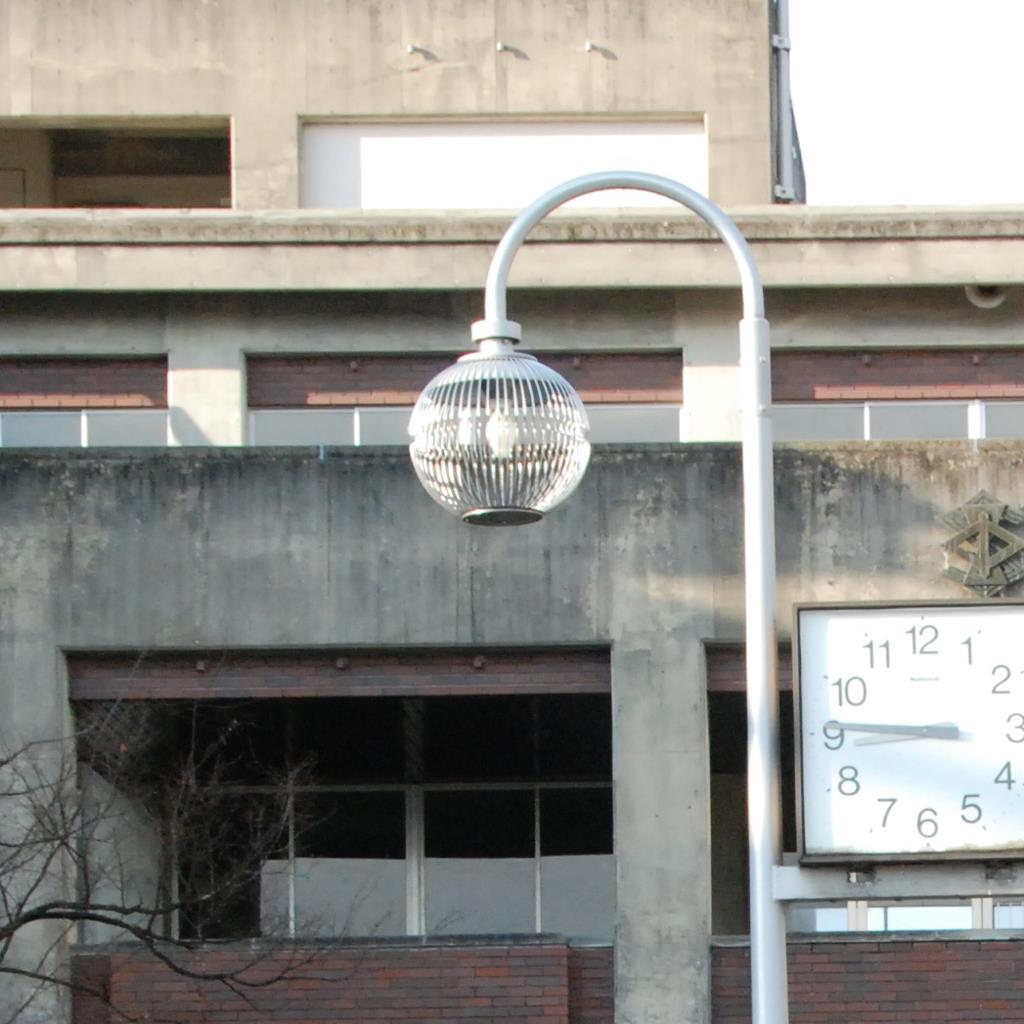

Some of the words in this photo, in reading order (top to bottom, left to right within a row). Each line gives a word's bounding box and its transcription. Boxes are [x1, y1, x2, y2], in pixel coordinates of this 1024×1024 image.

[863, 640, 891, 669] 11
[905, 625, 939, 654] 12
[961, 637, 973, 665] 1
[832, 676, 868, 707] 10
[991, 665, 1012, 695] 2
[822, 720, 846, 751] 9
[838, 766, 861, 796] 8
[994, 761, 1017, 790] 4
[877, 798, 898, 828] 7
[916, 808, 939, 838] 6
[960, 794, 983, 824] 5
